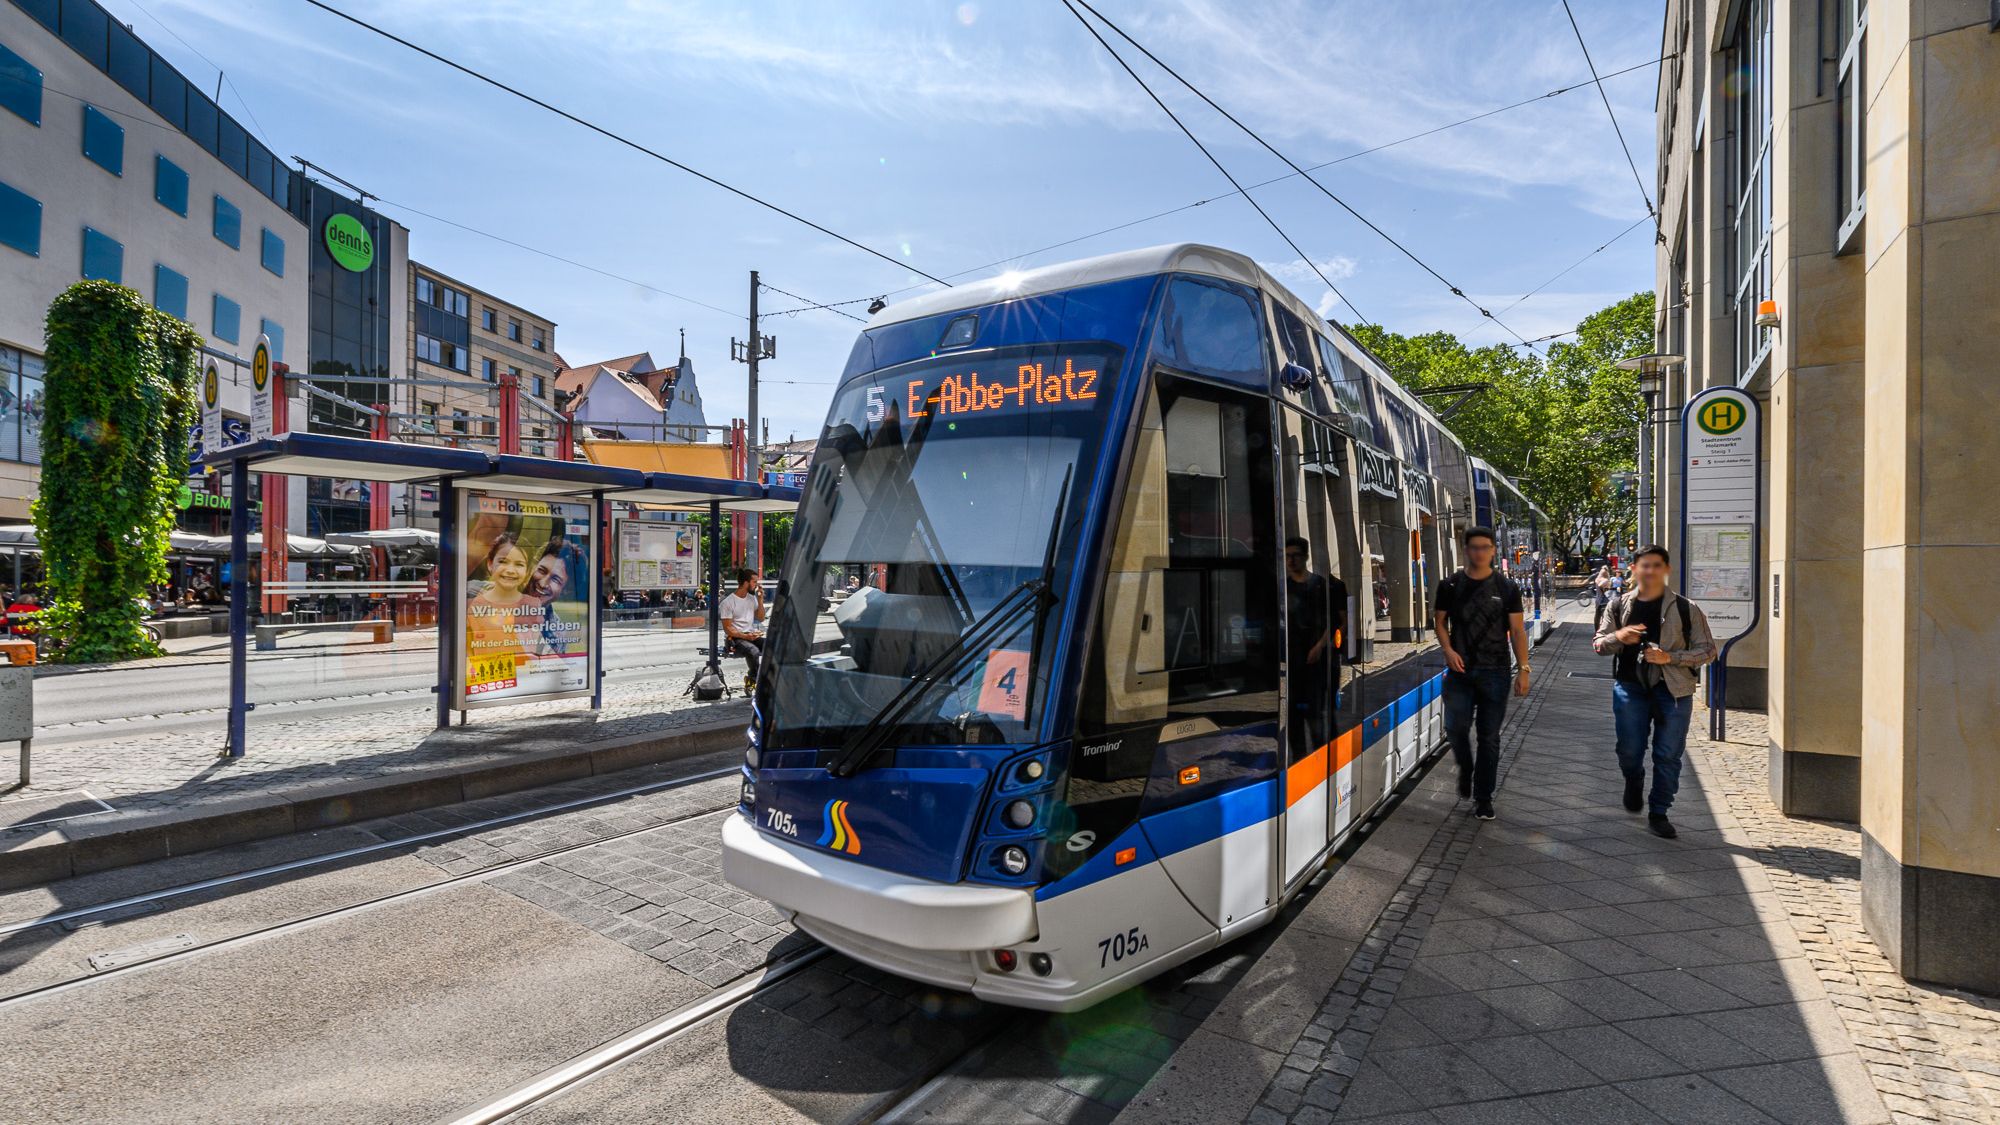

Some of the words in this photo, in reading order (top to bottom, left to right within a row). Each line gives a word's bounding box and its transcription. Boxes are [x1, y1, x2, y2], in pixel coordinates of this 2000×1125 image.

[866, 385, 885, 422] 5
[907, 359, 1097, 419] E.-Abbe-Platz
[1711, 405, 1732, 427] H
[194, 493, 263, 513] BIOMT
[498, 500, 563, 516] Holzmarkt
[471, 604, 498, 617] Wir
[500, 605, 546, 617] wollen
[502, 624, 530, 633] was
[531, 620, 581, 632] erleben
[470, 640, 486, 648] Mit
[487, 639, 502, 648] der
[503, 638, 526, 647] Bahn
[539, 636, 581, 645] Abenteuer
[996, 667, 1017, 695] 4
[1081, 740, 1122, 757] Tramino
[767, 807, 798, 837] 705A
[1098, 926, 1149, 968] 705A
